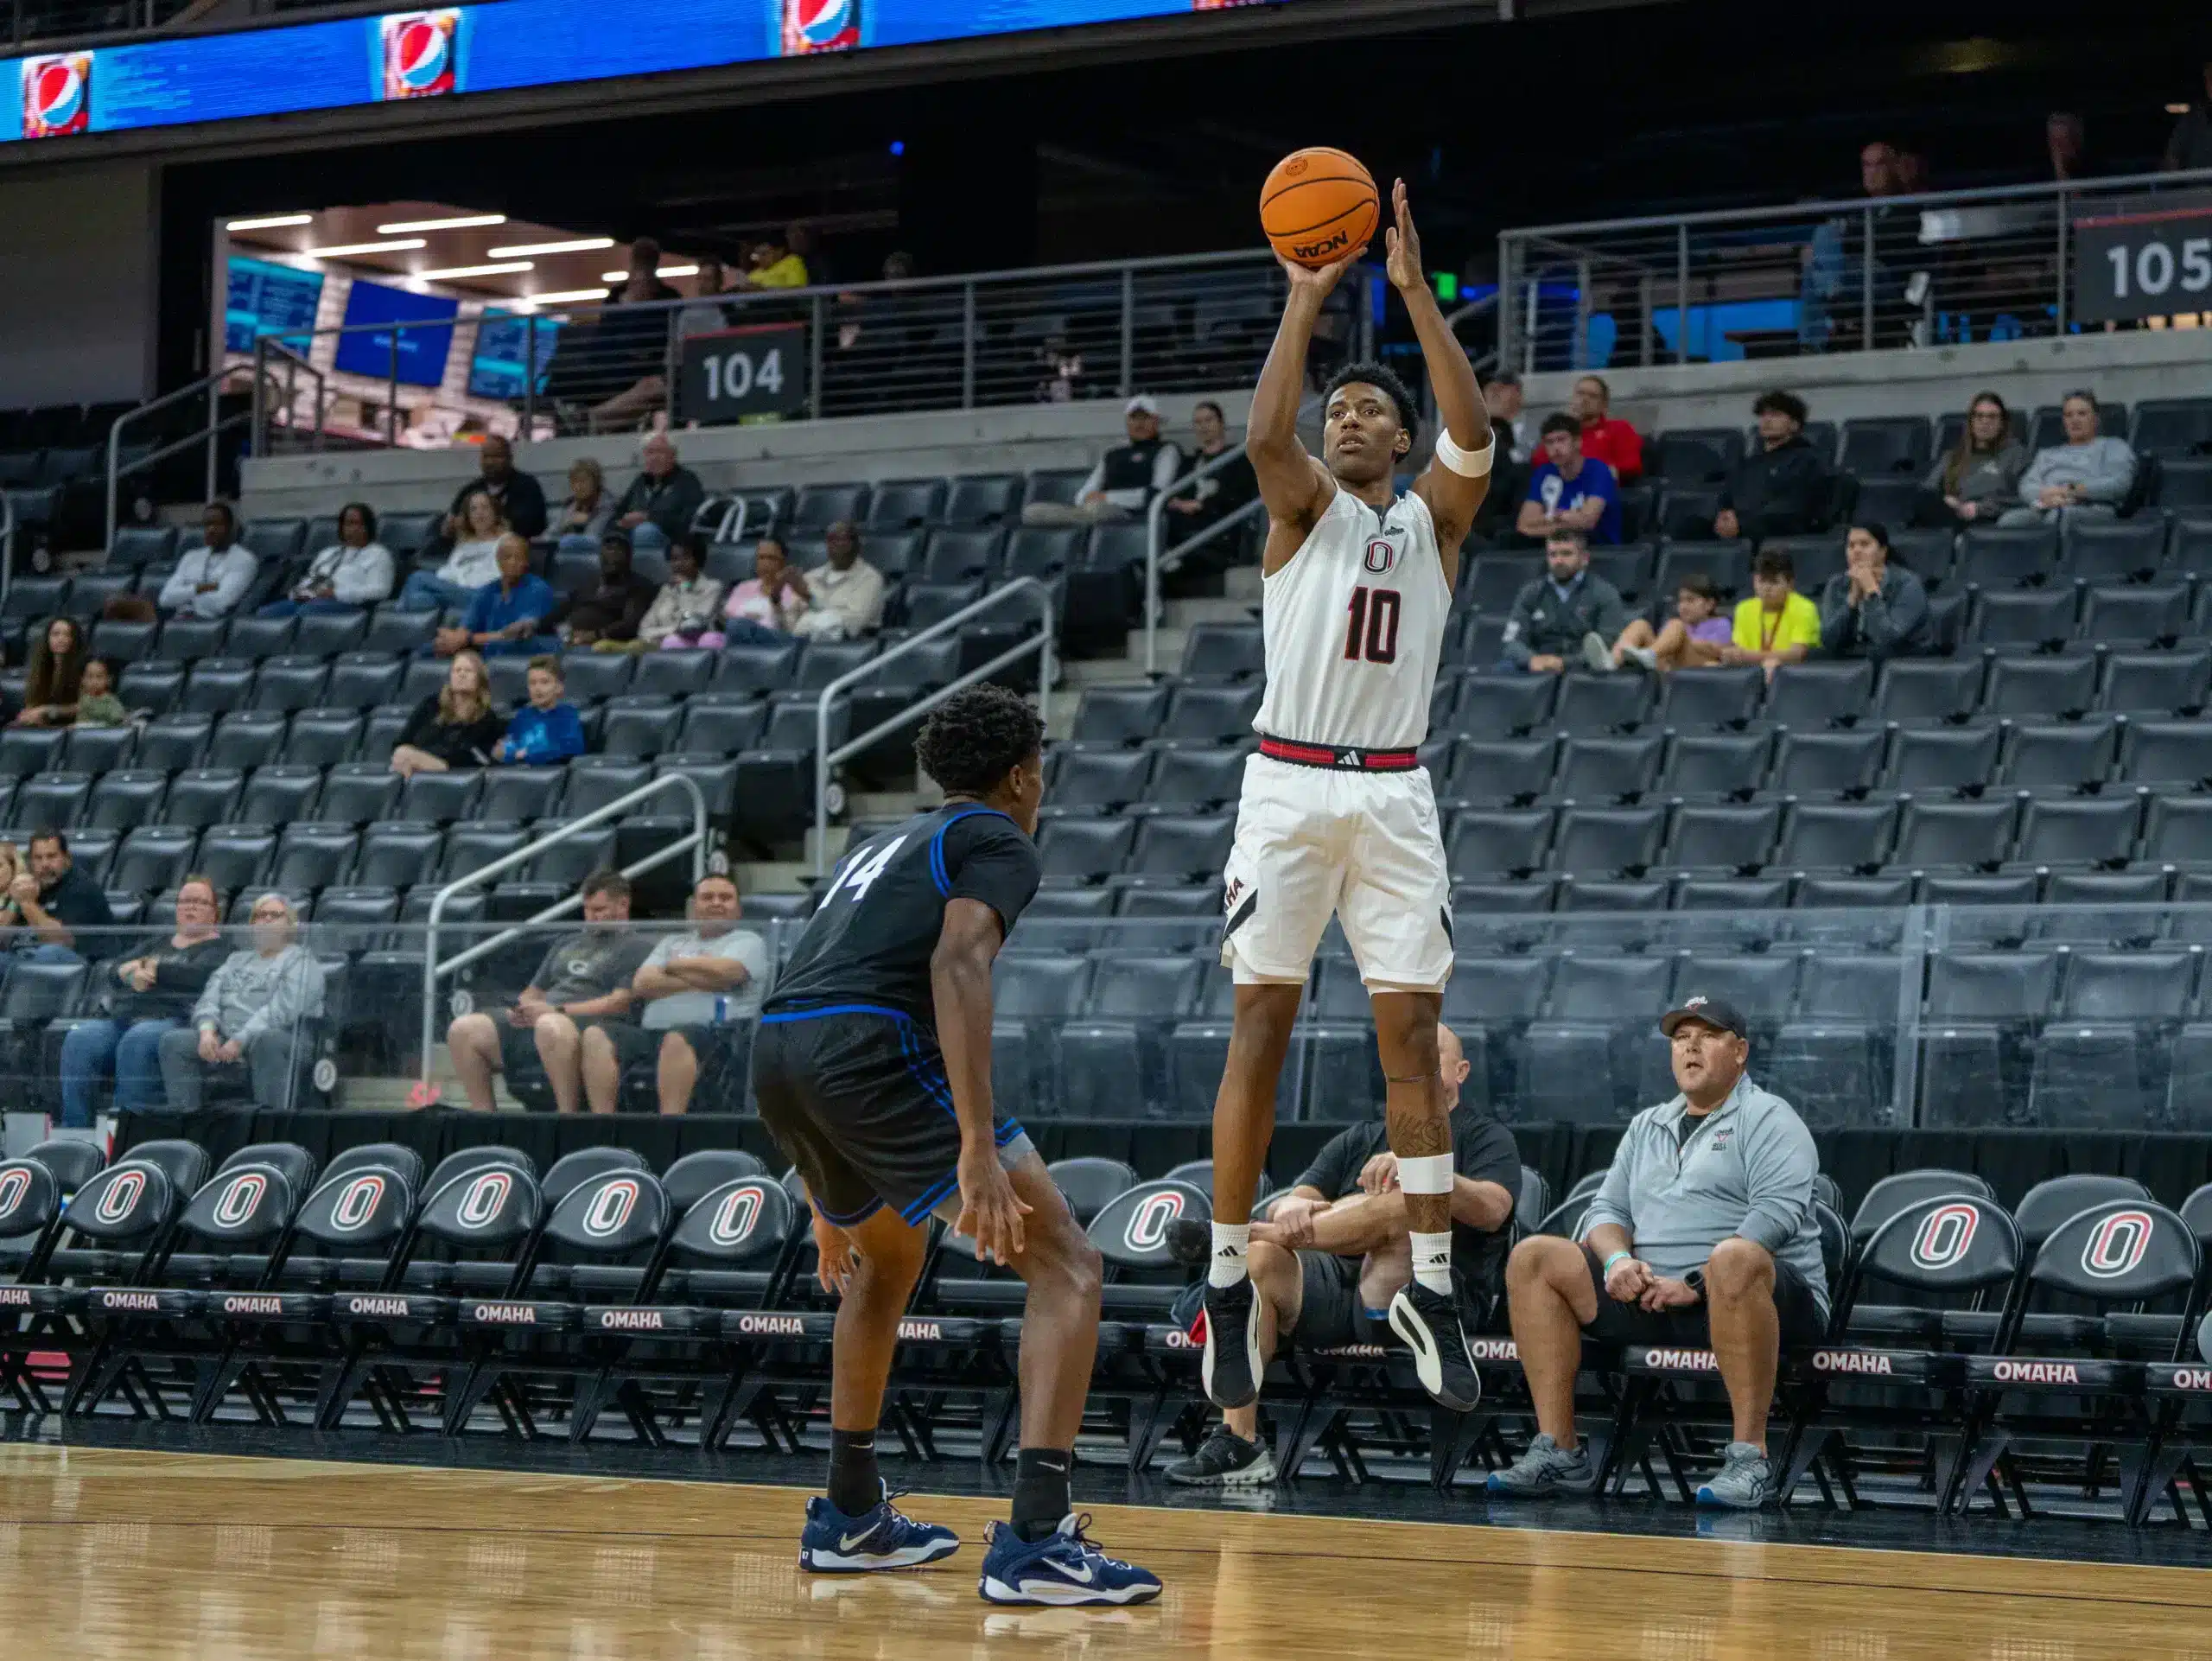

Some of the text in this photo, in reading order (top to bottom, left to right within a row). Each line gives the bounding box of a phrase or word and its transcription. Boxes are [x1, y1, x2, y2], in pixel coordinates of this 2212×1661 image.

[2106, 236, 2212, 298] 105
[702, 348, 785, 402] 104
[1344, 586, 1401, 665] 10
[817, 835, 907, 910] 14
[103, 1292, 158, 1309] OMAHA
[224, 1296, 283, 1314] OMAHA
[349, 1298, 409, 1315] OMAHA
[475, 1305, 536, 1323] OMAHA
[601, 1311, 663, 1329] OMAHA
[740, 1315, 804, 1333] OMAHA
[1471, 1340, 1522, 1360] OMA
[1644, 1349, 1719, 1371] OMAHA
[1812, 1351, 1892, 1374] OMAHA
[1993, 1361, 2080, 1384] OMAHA
